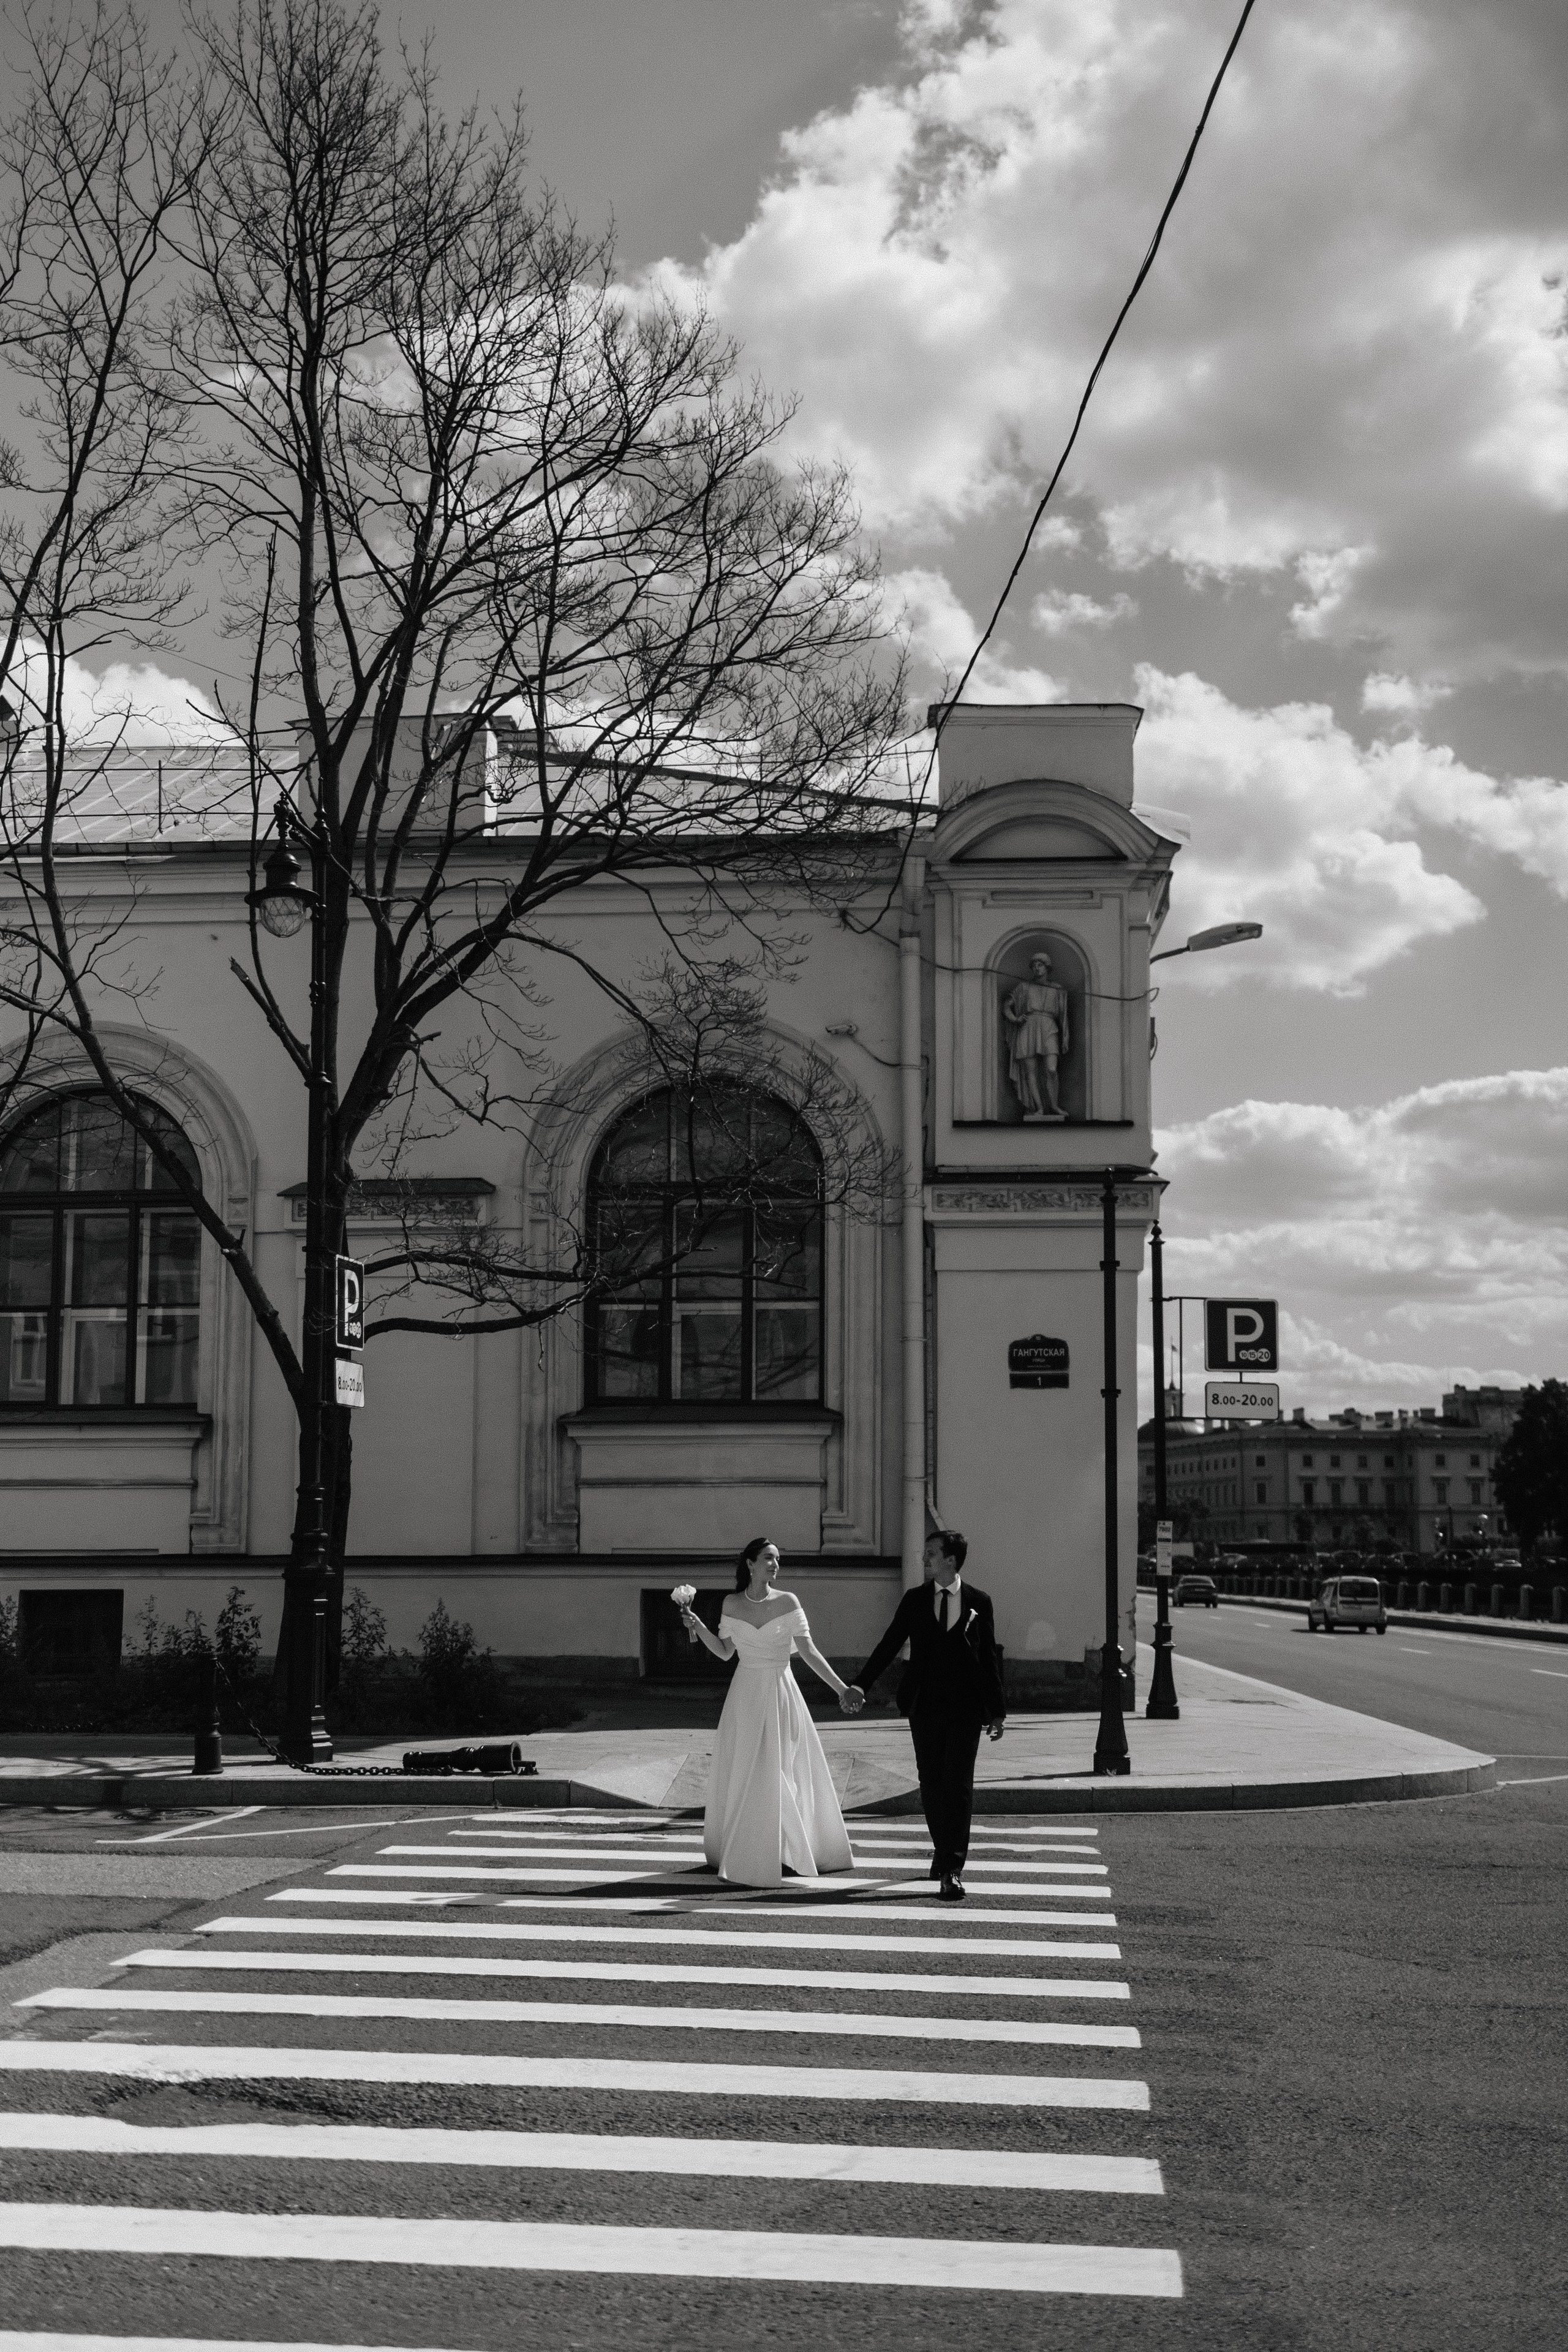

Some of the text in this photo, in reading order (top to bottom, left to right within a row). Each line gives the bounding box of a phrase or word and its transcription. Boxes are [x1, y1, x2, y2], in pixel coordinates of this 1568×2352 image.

[344, 1269, 360, 1336] P
[1227, 1308, 1264, 1362] P
[1013, 1348, 1065, 1357] ГАНГУТСКАЯ
[337, 1376, 363, 1392] 8.00-20.00
[1037, 1376, 1041, 1385] 1
[1212, 1393, 1273, 1406] 8.00-20.00
